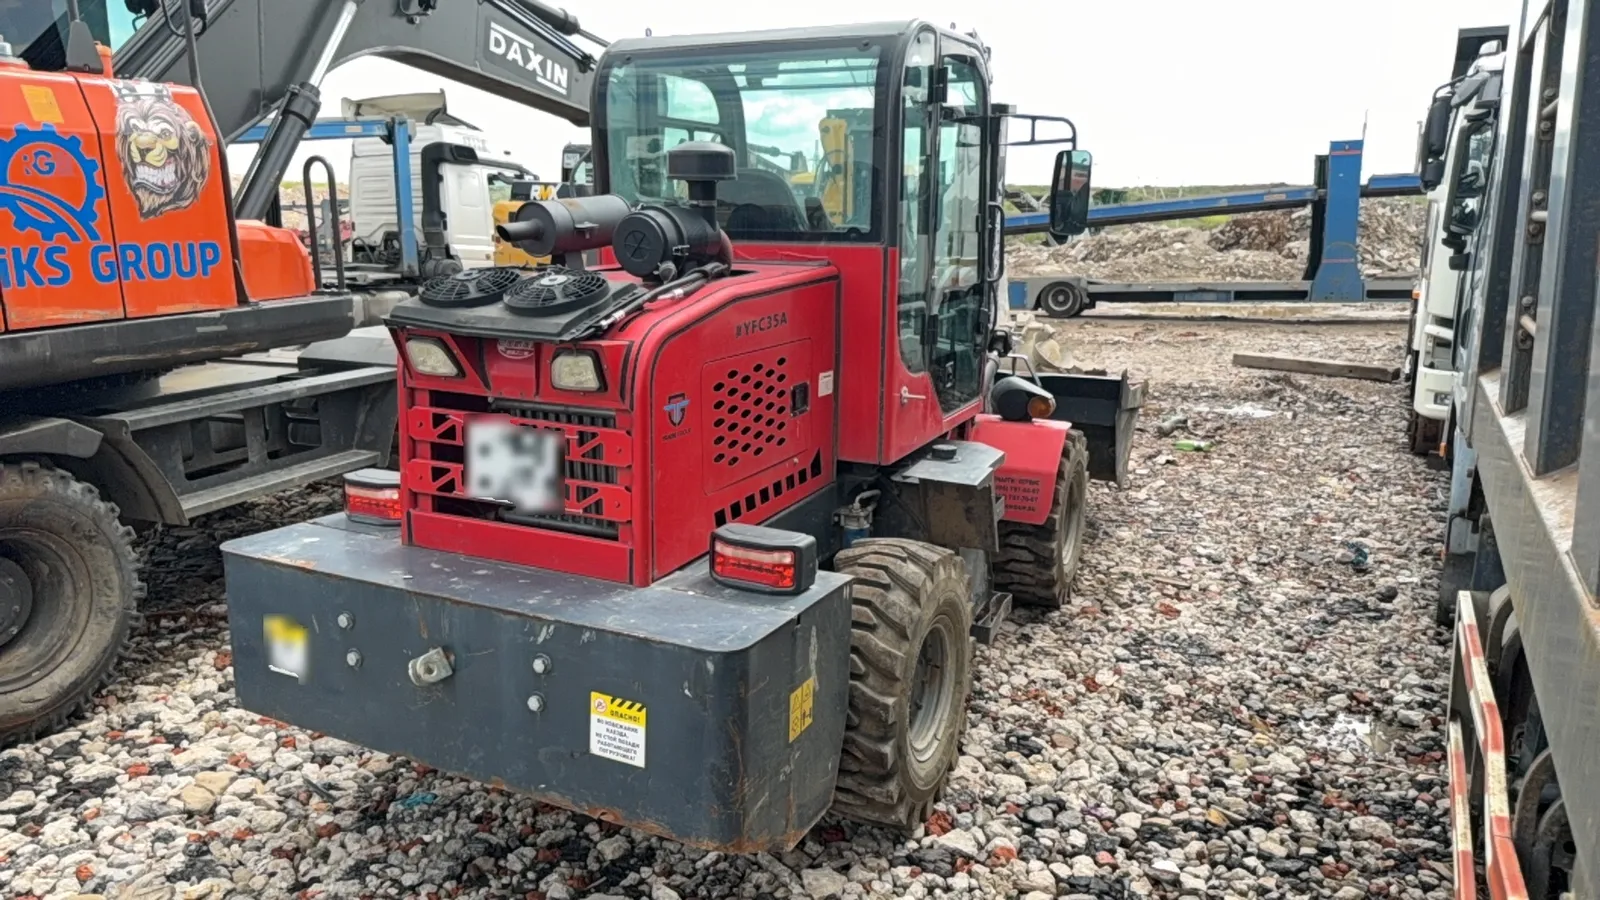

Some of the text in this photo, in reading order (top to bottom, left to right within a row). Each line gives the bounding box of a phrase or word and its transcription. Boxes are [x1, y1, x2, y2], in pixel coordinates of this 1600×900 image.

[489, 28, 568, 89] DAXIN
[530, 184, 560, 200] RMX
[90, 242, 220, 283] GROUP
[610, 710, 640, 723] ОПАСНО!
